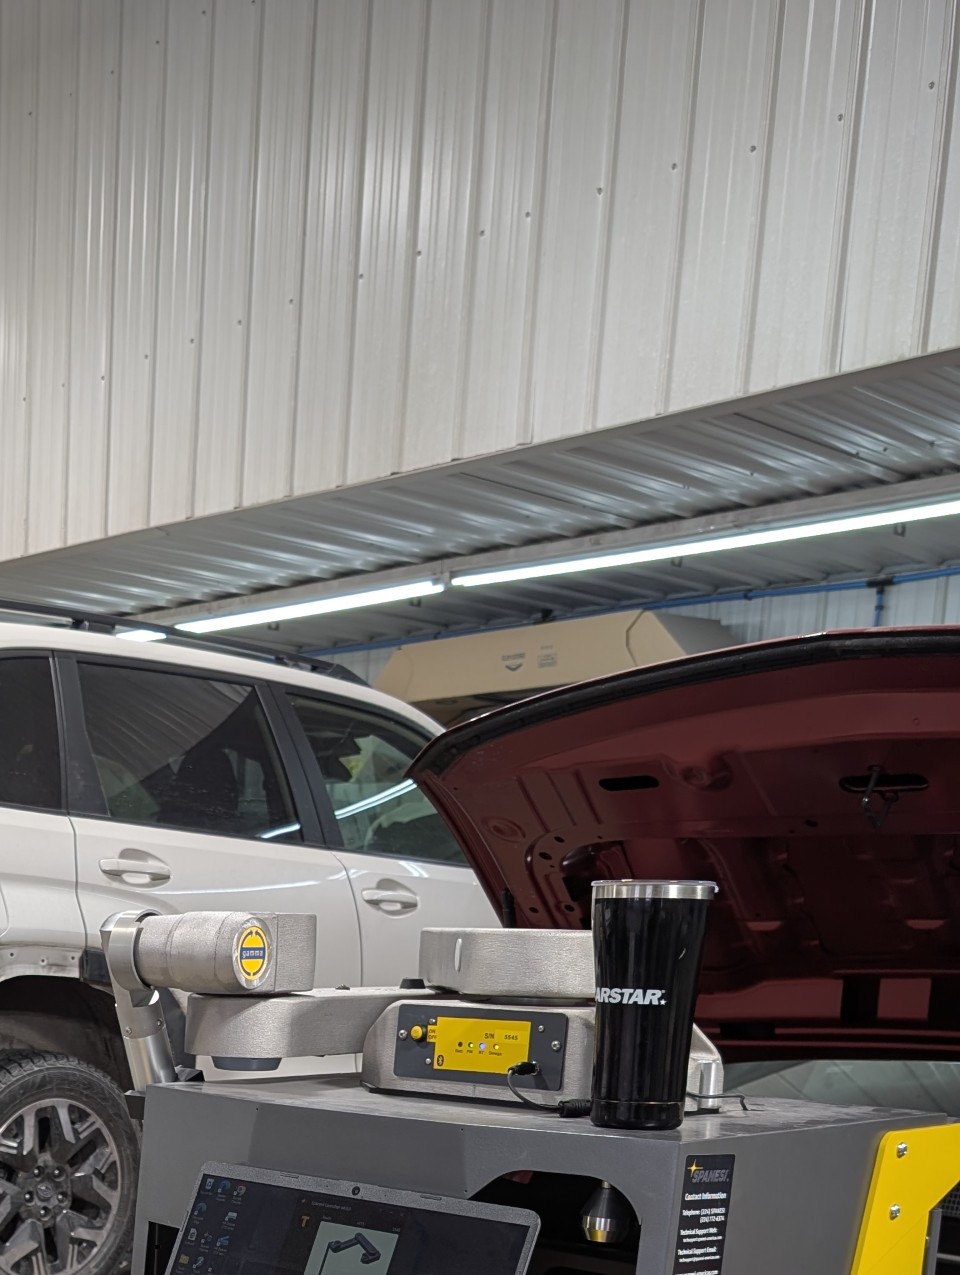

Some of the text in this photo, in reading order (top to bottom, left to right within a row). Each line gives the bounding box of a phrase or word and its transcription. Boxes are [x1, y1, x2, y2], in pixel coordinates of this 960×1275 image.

[242, 950, 264, 959] gamma
[595, 987, 662, 1005] ARSTAR
[484, 1032, 495, 1040] S/N
[692, 1169, 729, 1182] SPANESI
[685, 1191, 727, 1200] Contact Information
